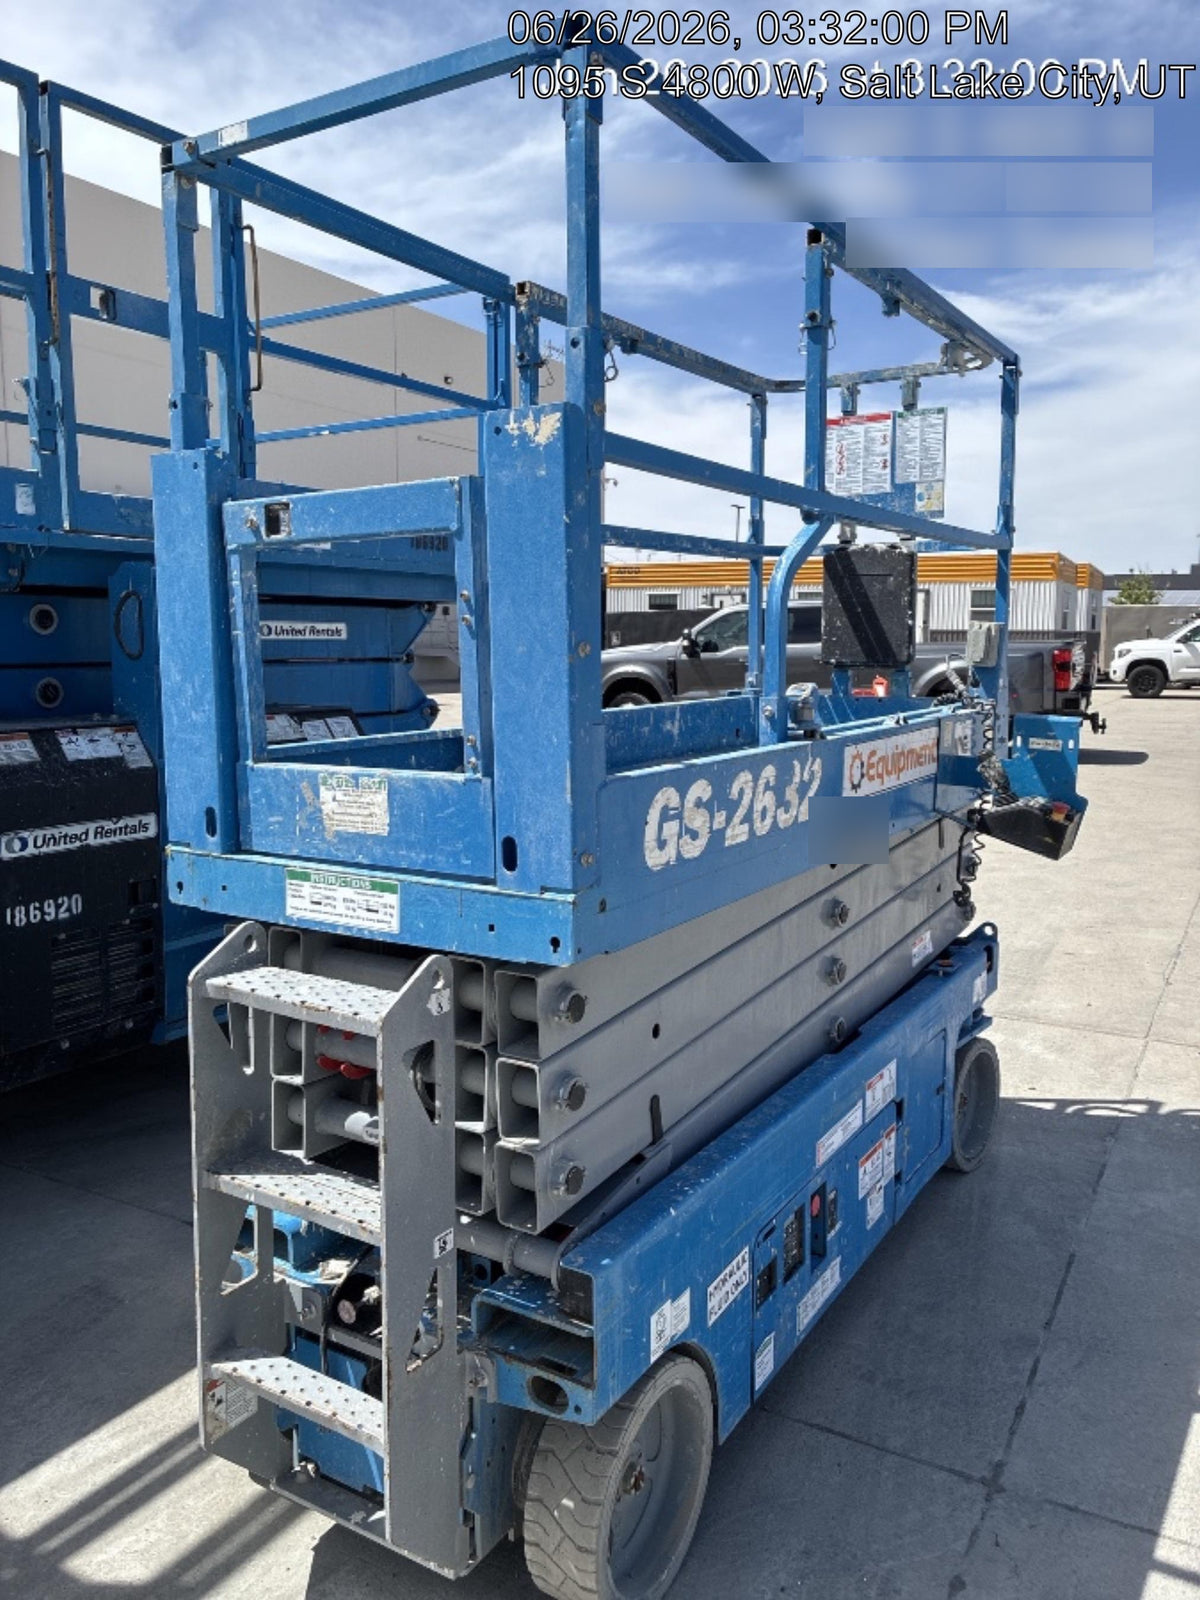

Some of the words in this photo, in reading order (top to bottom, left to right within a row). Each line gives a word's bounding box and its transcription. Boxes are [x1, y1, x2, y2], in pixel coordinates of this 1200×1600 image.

[274, 625, 307, 637] United
[309, 625, 342, 637] Rentals
[644, 756, 823, 871] GS-2632
[33, 828, 89, 850] United
[94, 819, 150, 840] Rentals
